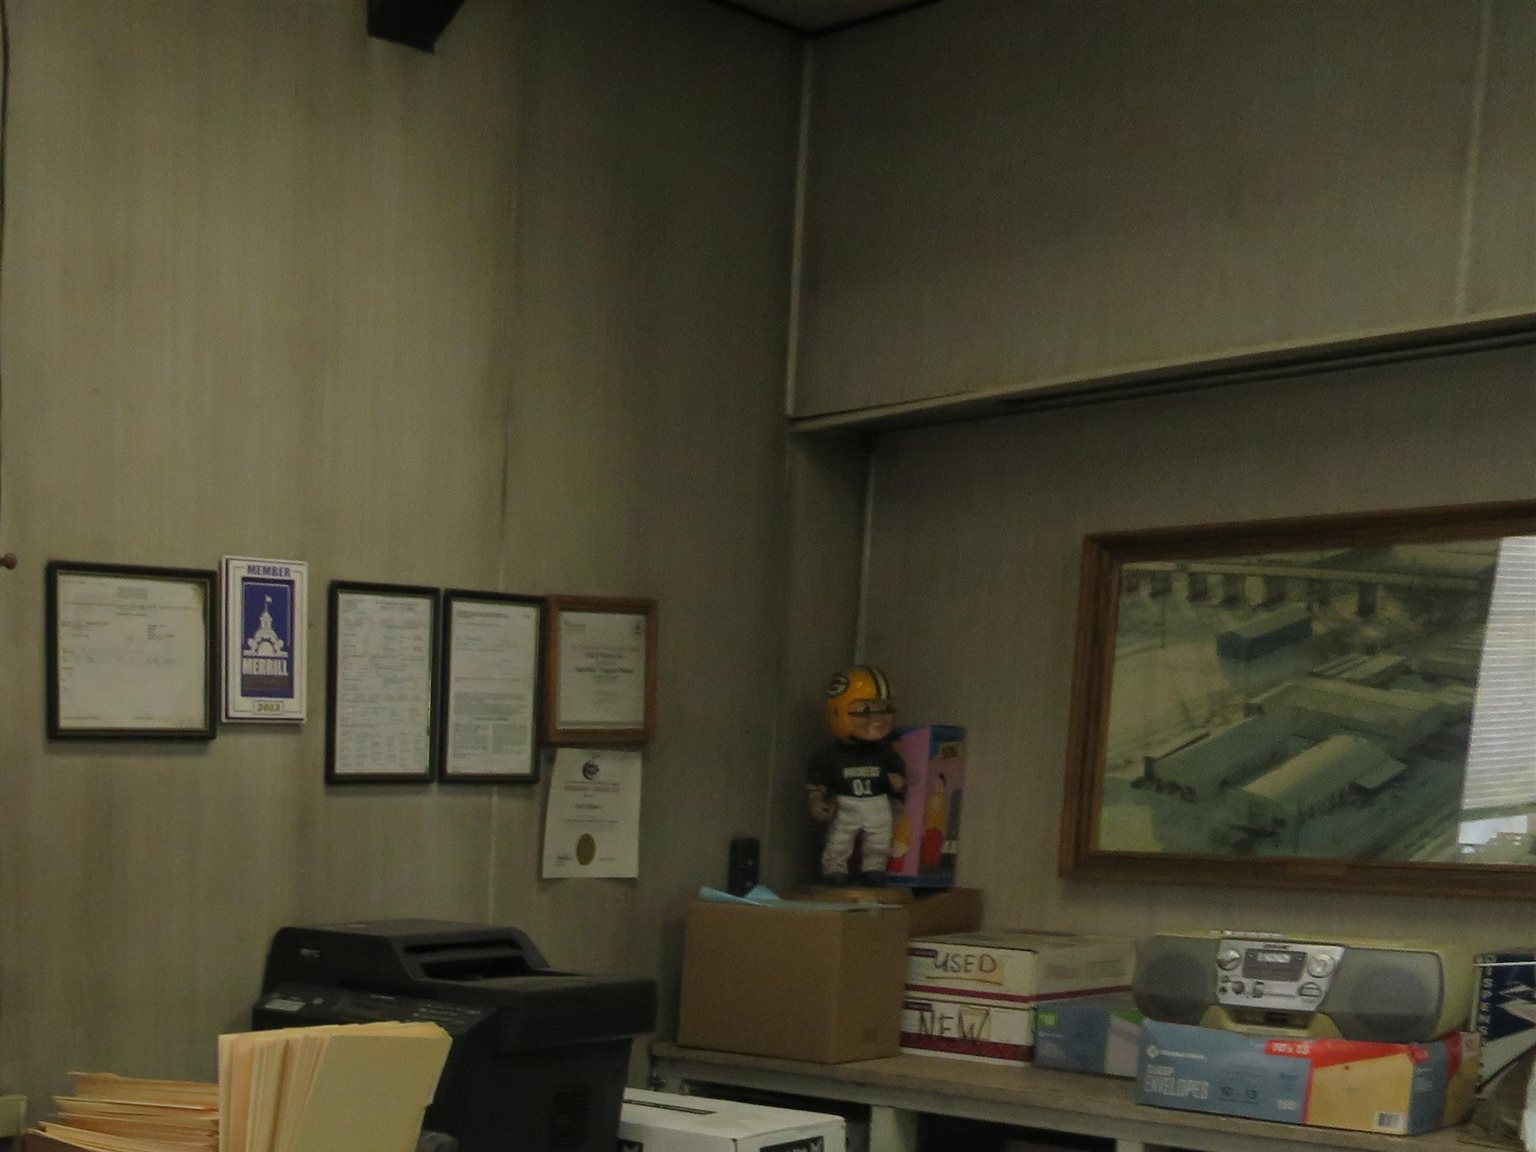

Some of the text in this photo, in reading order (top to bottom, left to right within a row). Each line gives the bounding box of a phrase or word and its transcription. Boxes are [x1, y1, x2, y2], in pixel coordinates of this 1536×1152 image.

[247, 564, 292, 578] MEMBER
[242, 658, 289, 676] MERRILL
[934, 953, 997, 973] USED
[919, 1007, 990, 1041] NEW
[1144, 1076, 1210, 1100] ENVELOPES
